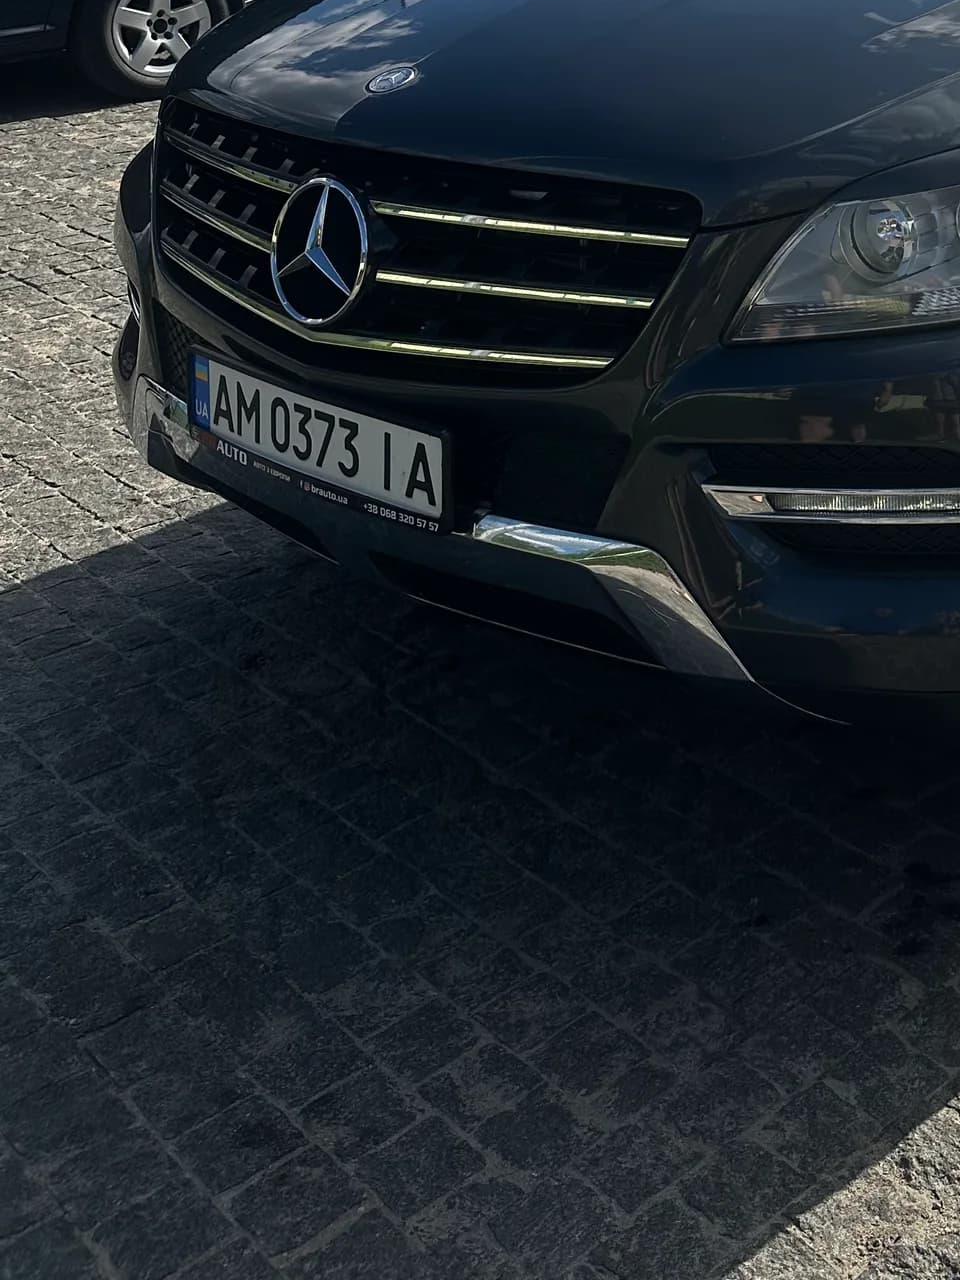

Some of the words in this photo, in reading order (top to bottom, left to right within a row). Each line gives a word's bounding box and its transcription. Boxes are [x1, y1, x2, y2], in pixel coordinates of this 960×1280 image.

[195, 399, 209, 420] UA
[213, 374, 260, 444] AM
[270, 397, 360, 478] 0373
[383, 431, 437, 507] IA
[216, 439, 248, 466] AUTO
[311, 483, 349, 505] brauto.ua
[363, 503, 379, 515] +38
[380, 507, 397, 520] 068
[398, 512, 415, 525] 320
[416, 518, 427, 529] 57
[428, 521, 439, 532] 57
